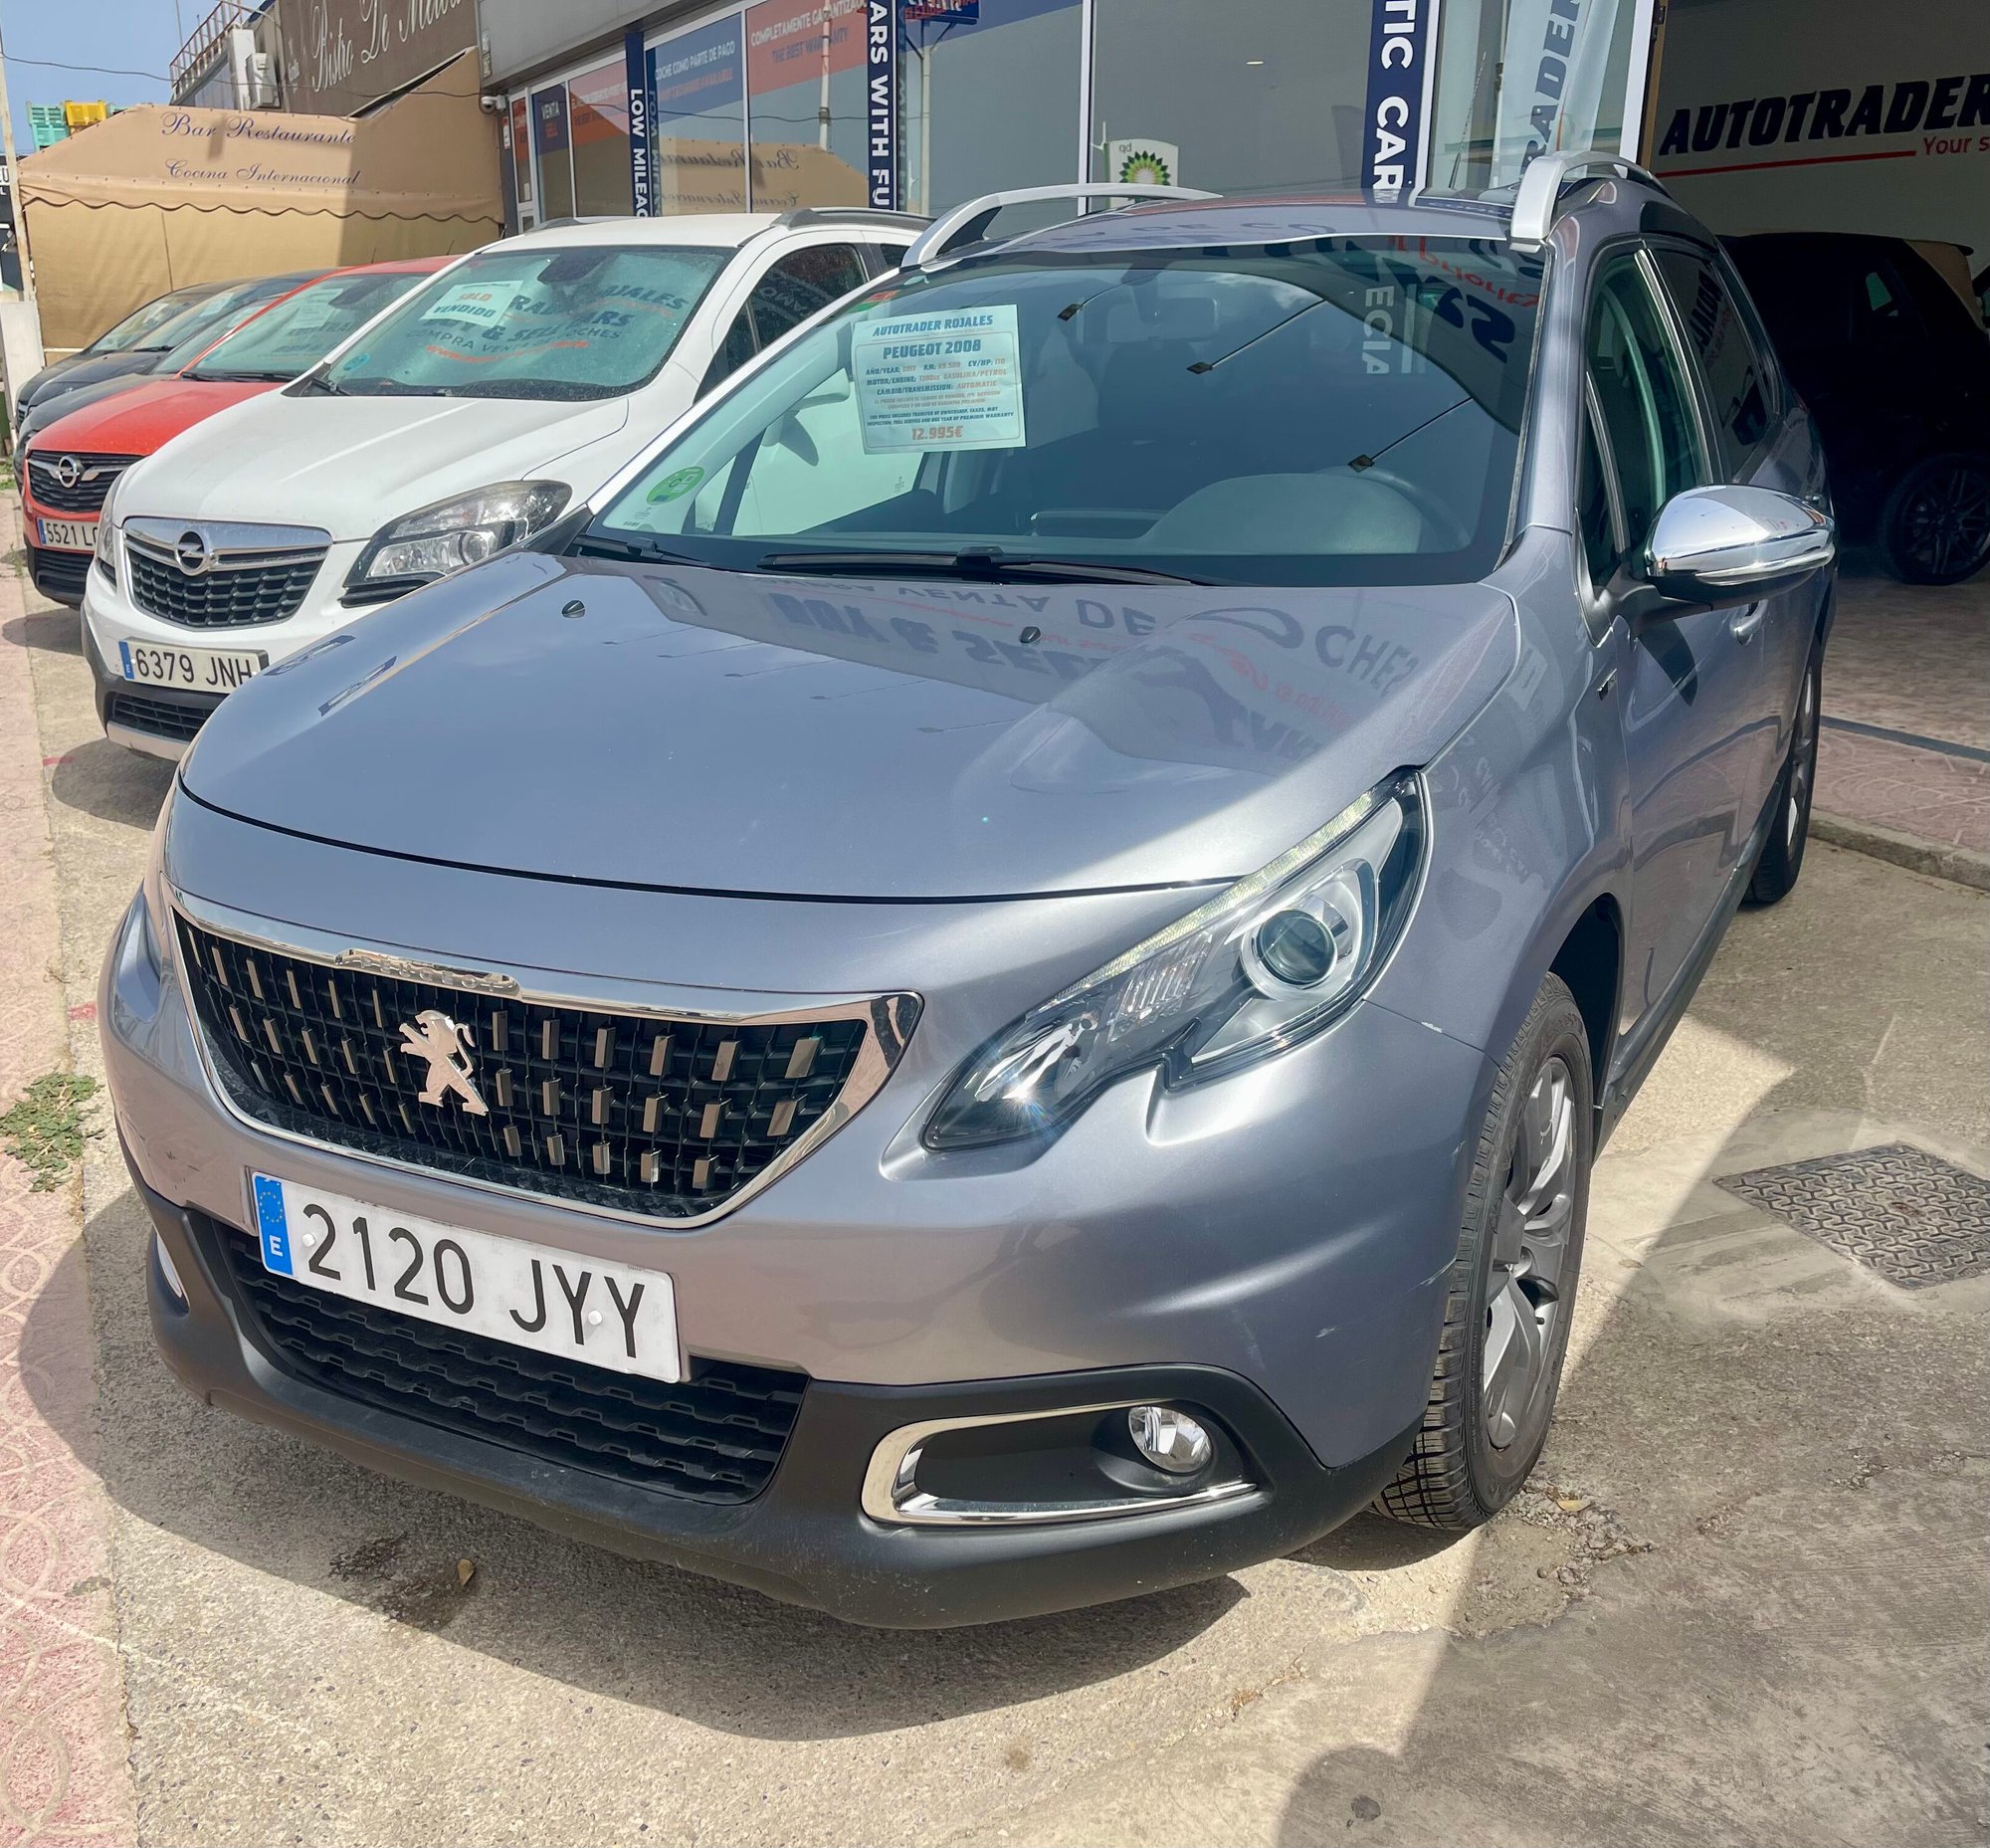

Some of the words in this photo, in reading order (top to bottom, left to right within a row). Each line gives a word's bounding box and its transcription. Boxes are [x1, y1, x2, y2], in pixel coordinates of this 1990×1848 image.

[630, 89, 646, 137] LOW
[871, 74, 890, 157] WITH
[1659, 74, 1990, 155] AUTOTRADER
[160, 110, 216, 136] Bar
[226, 115, 356, 143] Restaurante
[1923, 135, 1972, 156] Your
[165, 158, 229, 180] Cocina
[236, 162, 361, 185] Internacional
[434, 304, 497, 317] VENDIDO
[873, 320, 941, 336] AUTOTRADER
[944, 315, 993, 329] ROJALES
[883, 342, 942, 359] PEUGEOT
[945, 339, 981, 354] 2008
[911, 425, 963, 441] 12.995€
[47, 521, 78, 544] 5521
[135, 648, 195, 684] 6379
[206, 655, 252, 688] JNH
[270, 1235, 284, 1257] E
[302, 1203, 475, 1315] 2120
[508, 1259, 646, 1359] JYY
